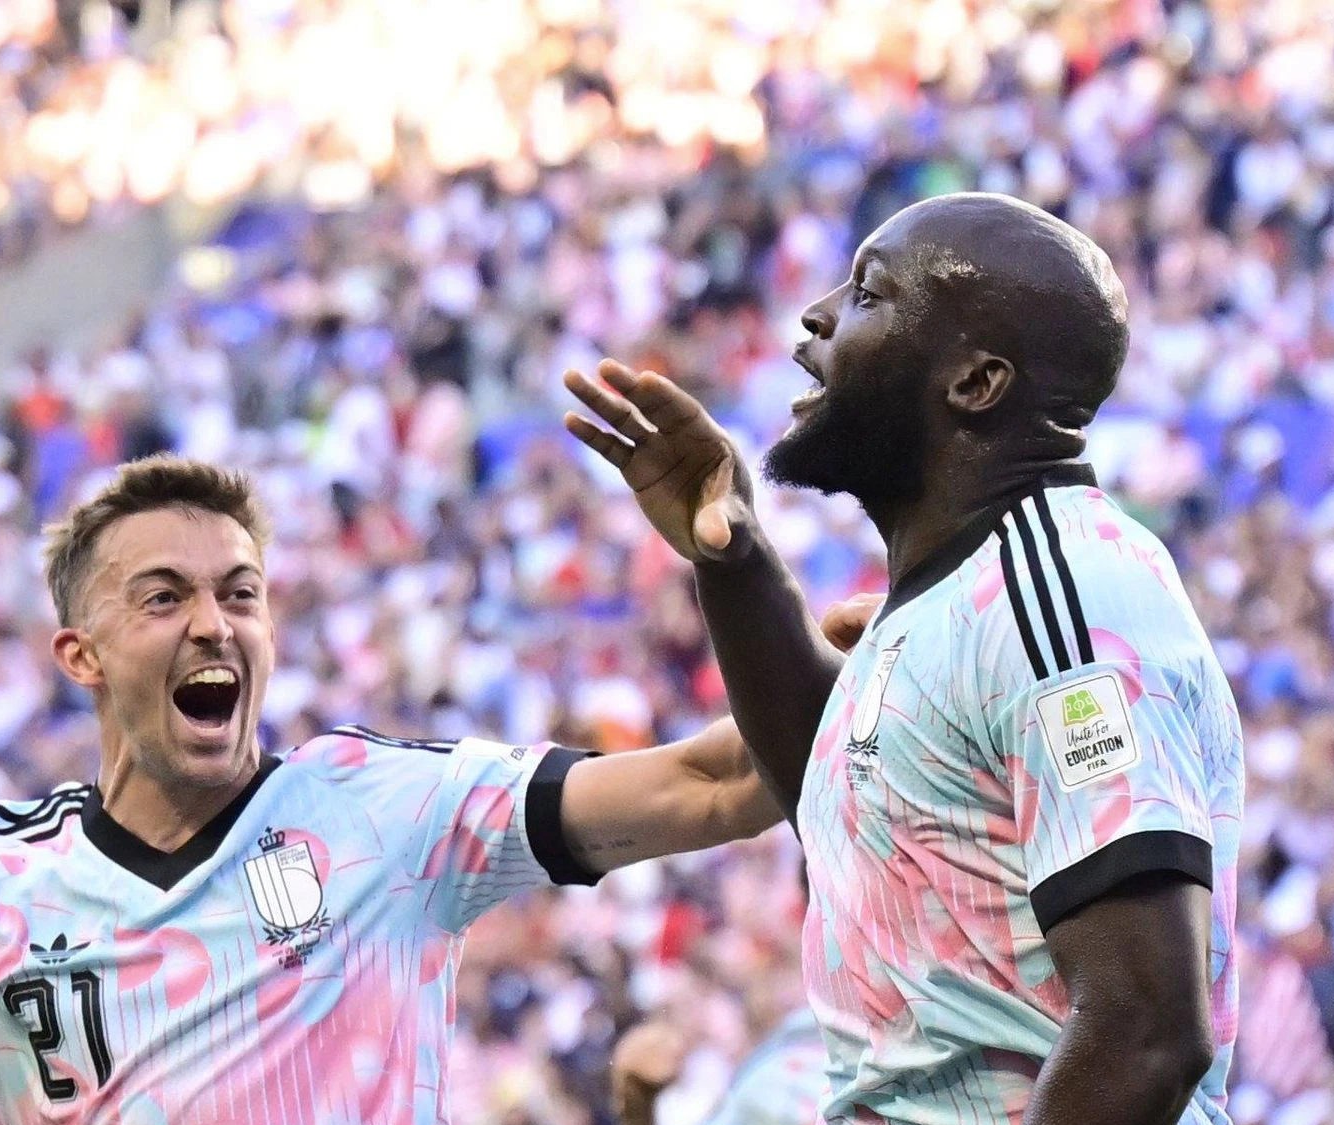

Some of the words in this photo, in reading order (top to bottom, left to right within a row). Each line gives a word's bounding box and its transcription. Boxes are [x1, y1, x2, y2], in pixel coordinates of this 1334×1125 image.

[1064, 735, 1125, 767] EDUCATION
[1087, 759, 1108, 771] FIFA
[2, 970, 115, 1103] 21
